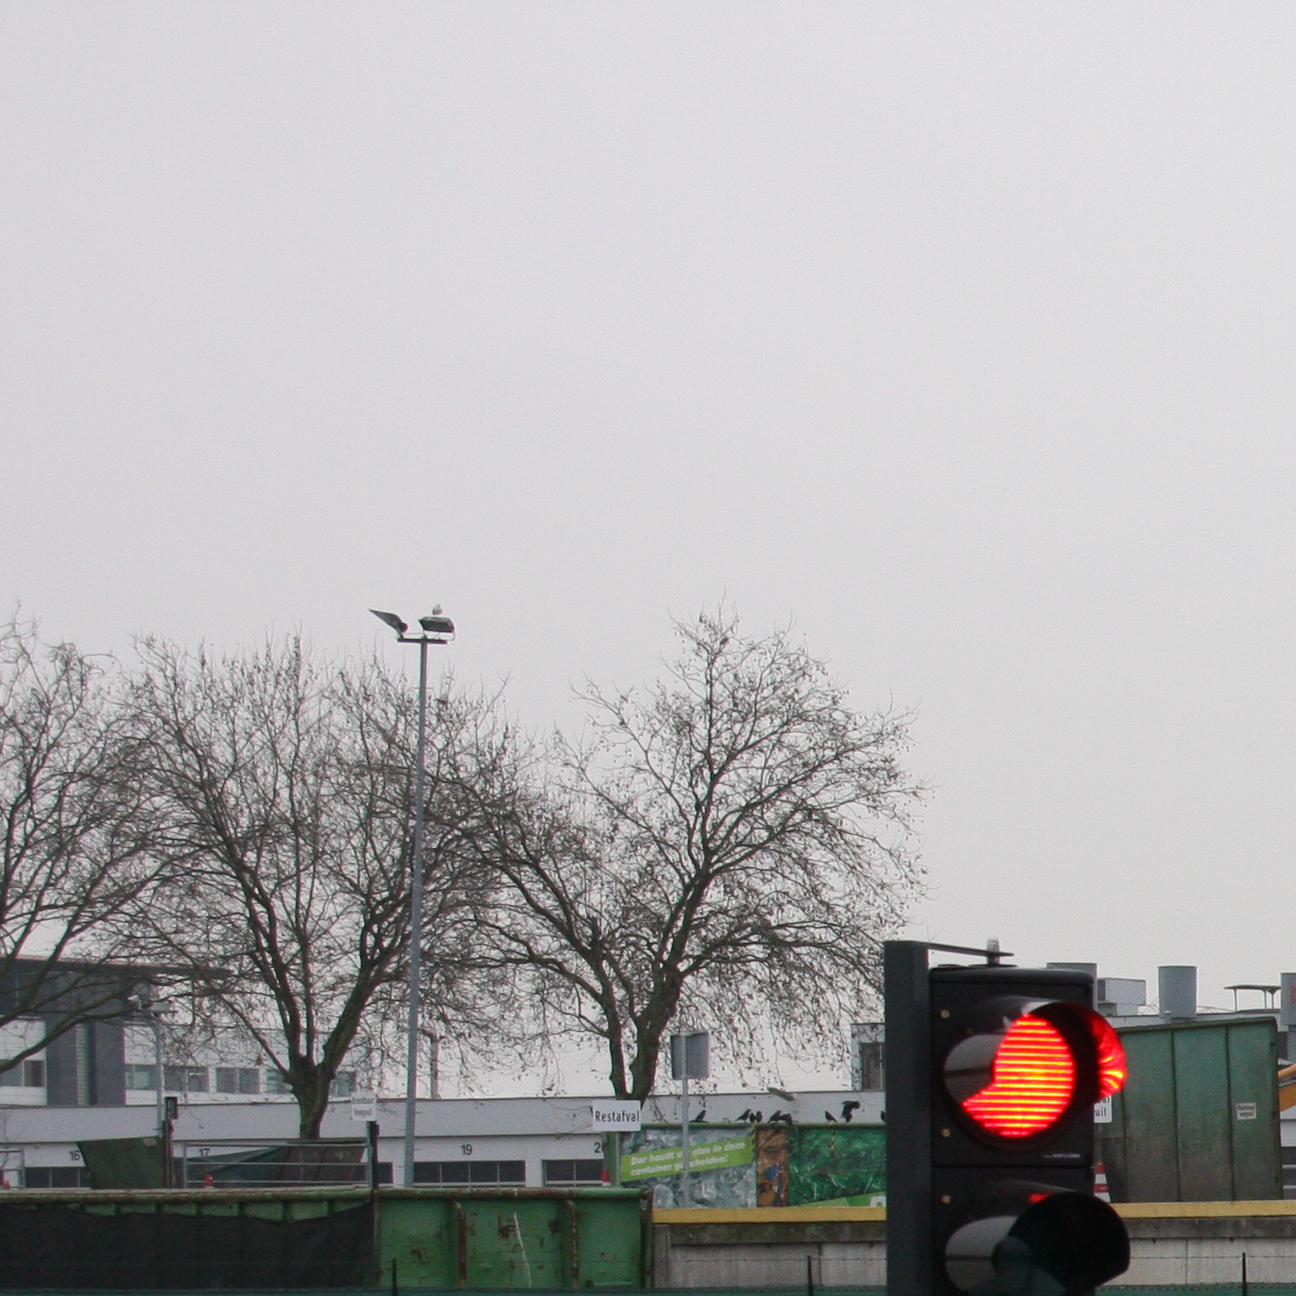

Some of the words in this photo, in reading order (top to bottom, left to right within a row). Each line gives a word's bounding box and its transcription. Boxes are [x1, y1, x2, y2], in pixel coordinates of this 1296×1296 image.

[594, 1108, 640, 1123] Restafval
[460, 1144, 473, 1155] 19
[69, 1150, 80, 1161] 16
